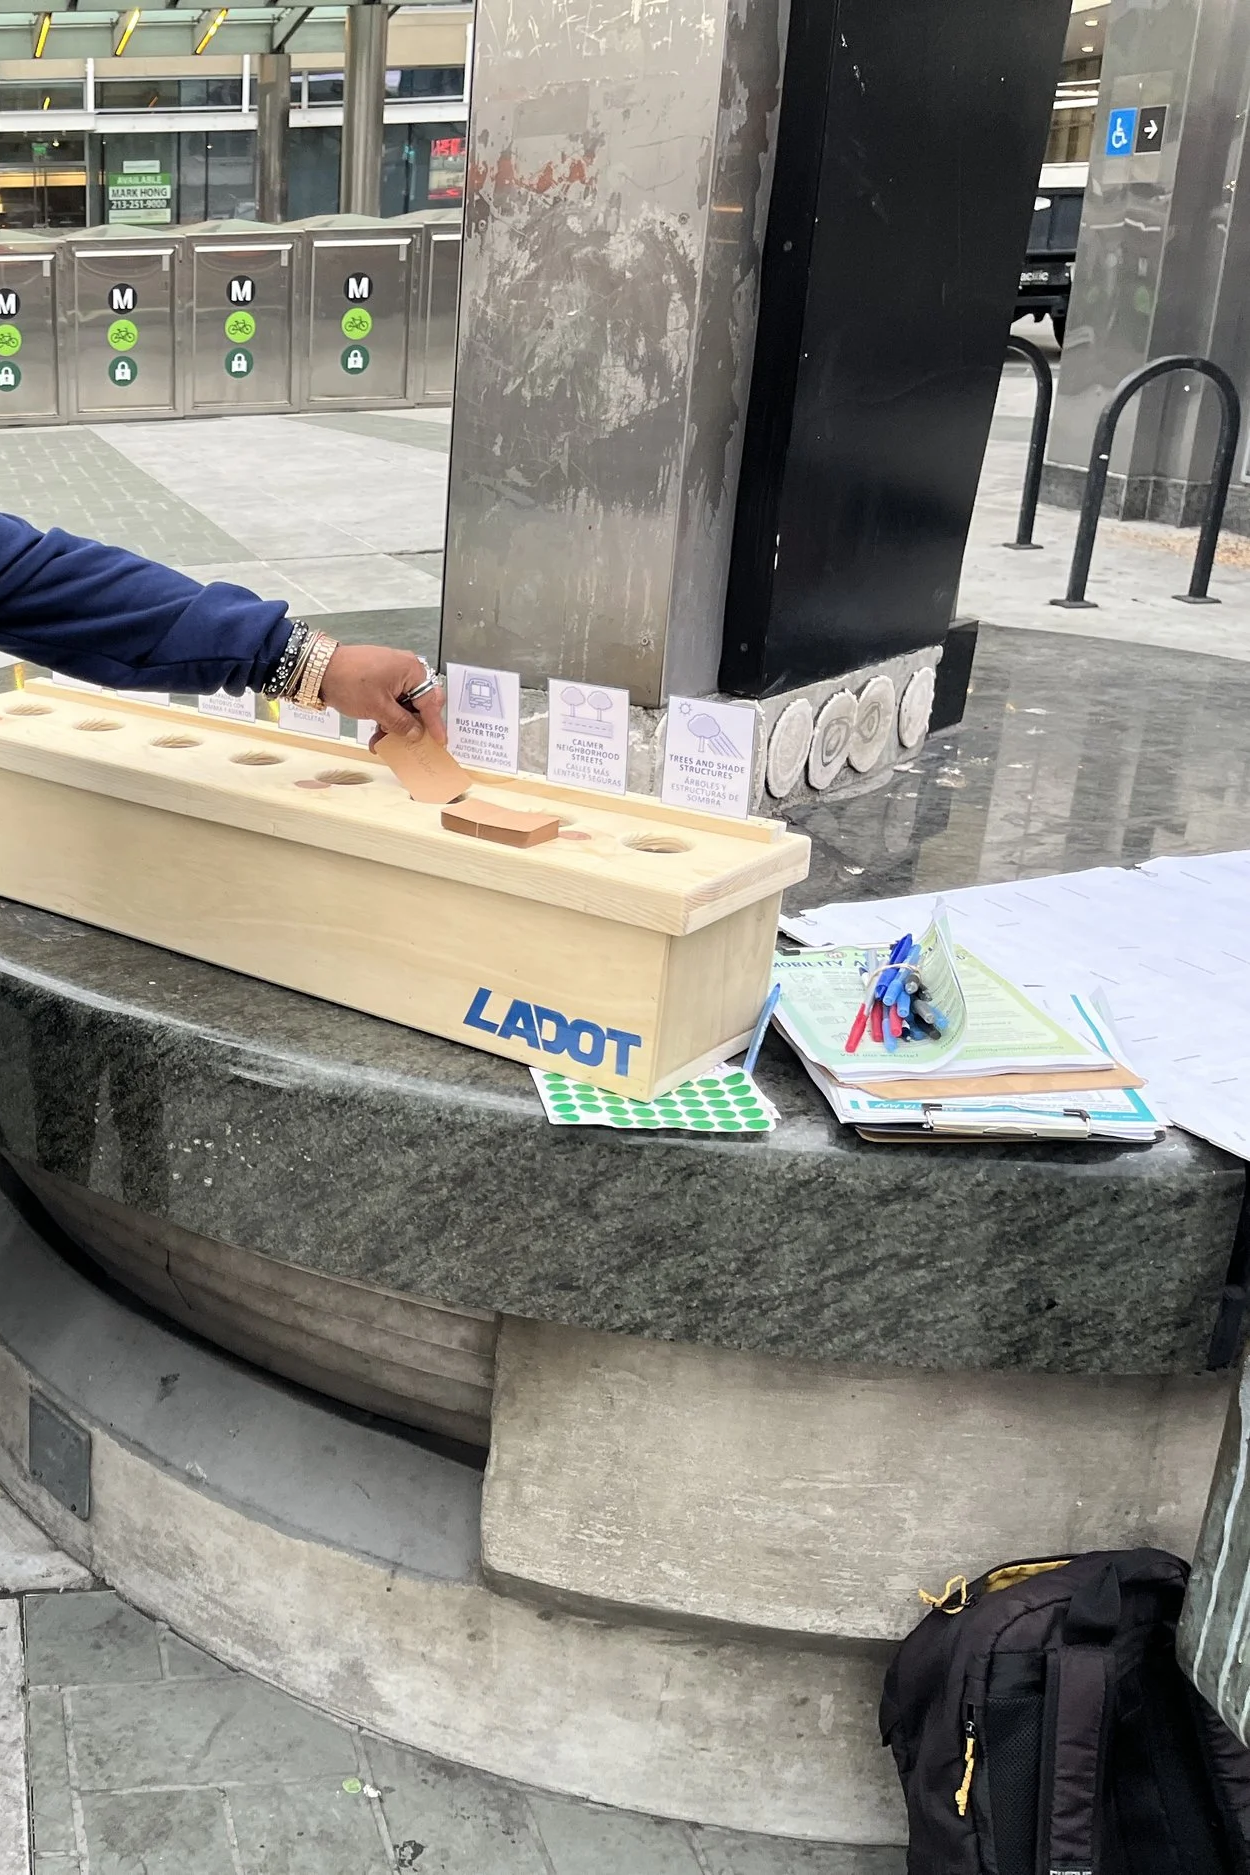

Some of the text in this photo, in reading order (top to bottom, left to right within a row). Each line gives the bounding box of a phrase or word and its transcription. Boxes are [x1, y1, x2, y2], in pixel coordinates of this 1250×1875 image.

[116, 175, 162, 185] AVAILABLE
[111, 187, 168, 198] MARK HONG
[455, 717, 509, 734] BUS LANES FOR
[459, 725, 505, 741] FASTER TRIPS
[489, 742, 504, 751] PARA
[572, 738, 604, 750] CALMER
[492, 750, 508, 759] PARA
[556, 743, 620, 761] NEIGHBORHOOD
[571, 754, 603, 766] STREETS
[669, 754, 745, 774] TREES AND SHADE
[565, 763, 591, 774] CALLES
[679, 764, 733, 780] STRUCTURES
[553, 767, 580, 779] LENTAS
[588, 774, 622, 787] SEGURAS
[671, 783, 739, 802] ESTRUCTURAS DE
[687, 793, 721, 806] SOMBRA
[462, 987, 642, 1077] LADOT
